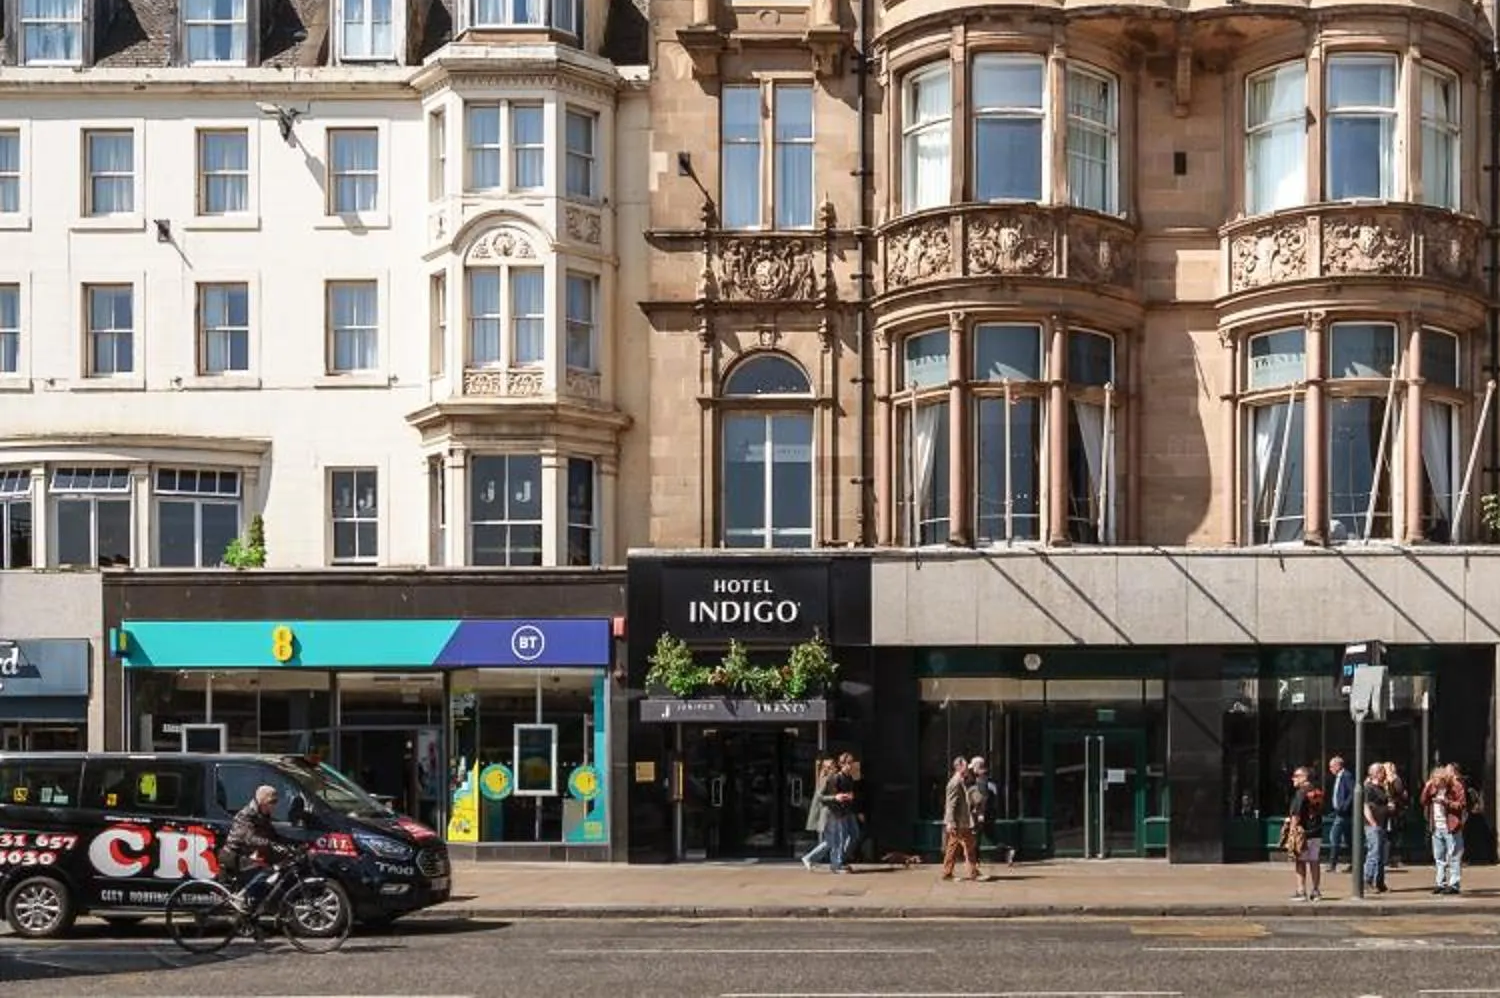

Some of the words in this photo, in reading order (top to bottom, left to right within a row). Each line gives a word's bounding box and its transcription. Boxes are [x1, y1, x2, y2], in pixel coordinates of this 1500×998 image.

[713, 579, 774, 594] HOTEL
[688, 600, 799, 624] INDIGO
[519, 635, 538, 650] BT
[35, 834, 79, 851] 657
